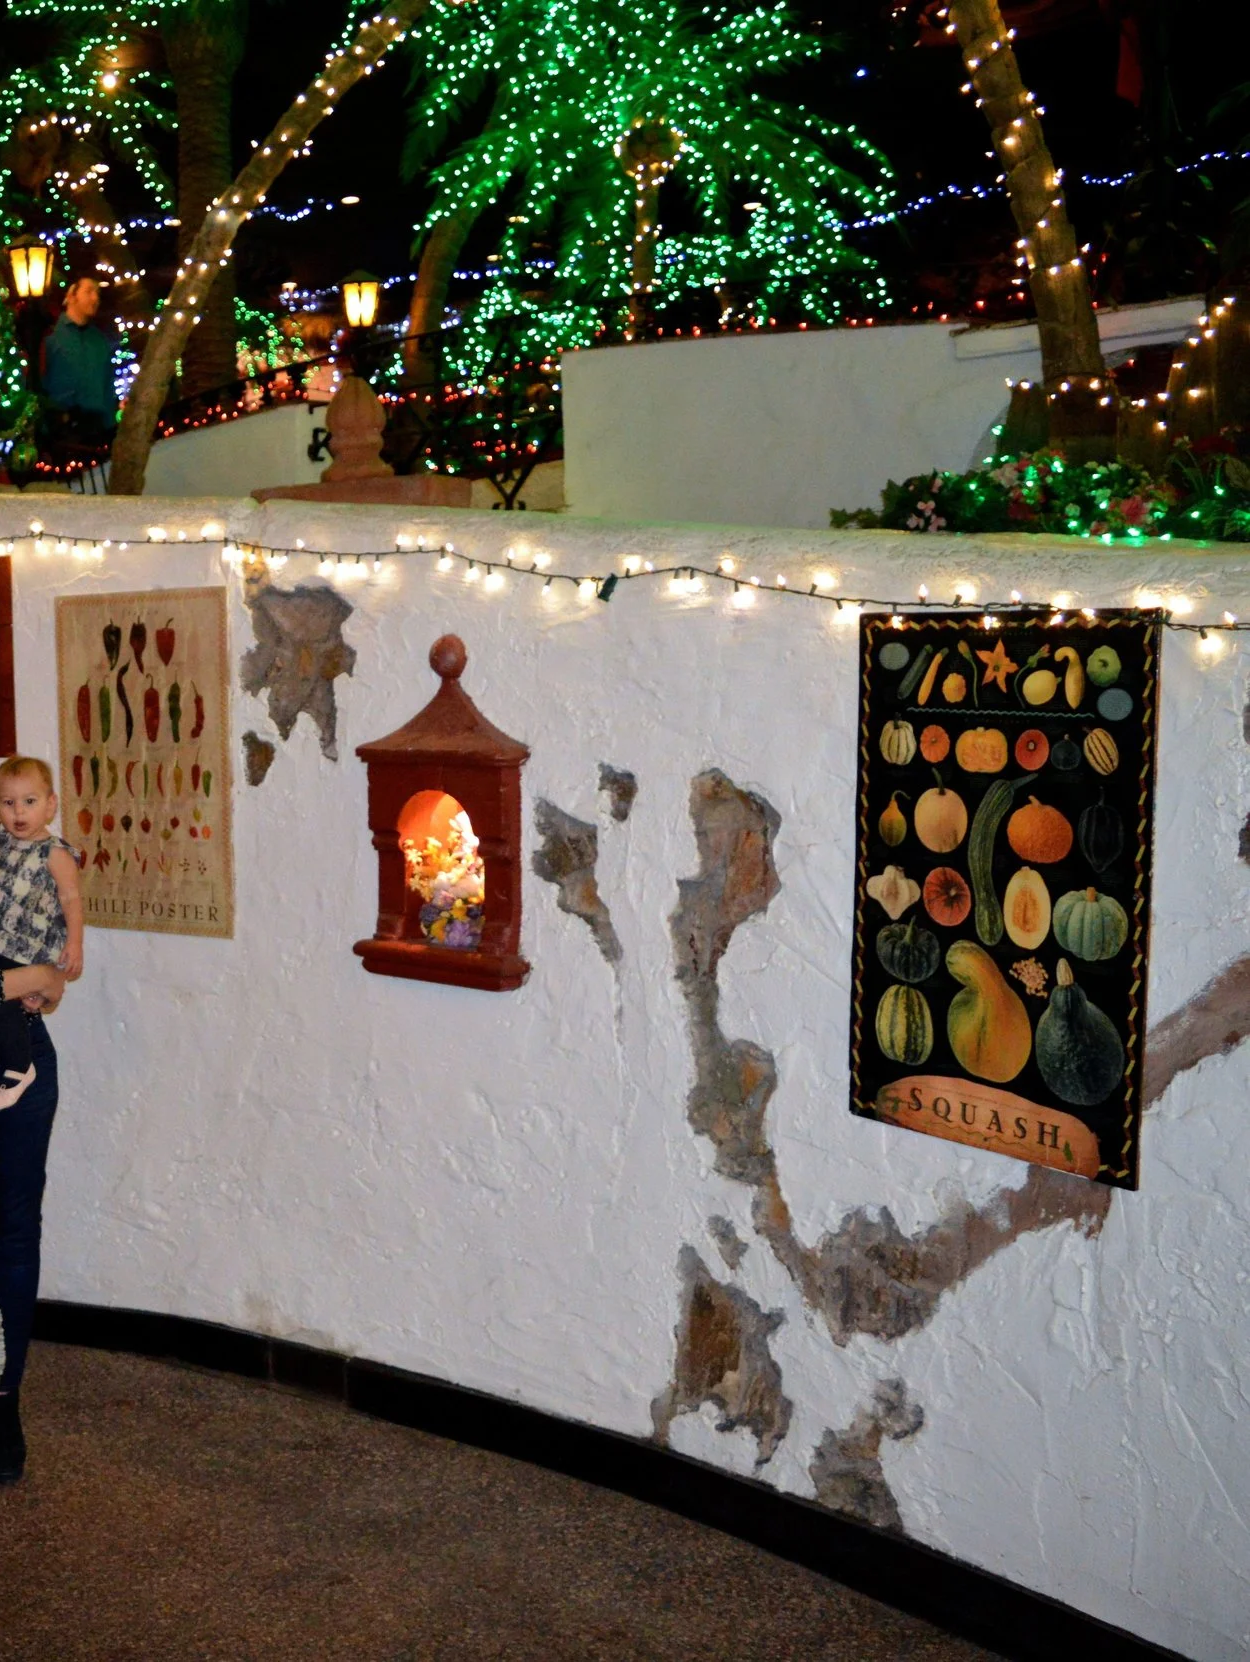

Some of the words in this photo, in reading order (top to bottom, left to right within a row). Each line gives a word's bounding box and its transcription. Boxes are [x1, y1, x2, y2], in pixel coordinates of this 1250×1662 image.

[82, 896, 132, 915] HILE
[139, 899, 219, 922] POSTER
[908, 1086, 1062, 1150] SQUASH
